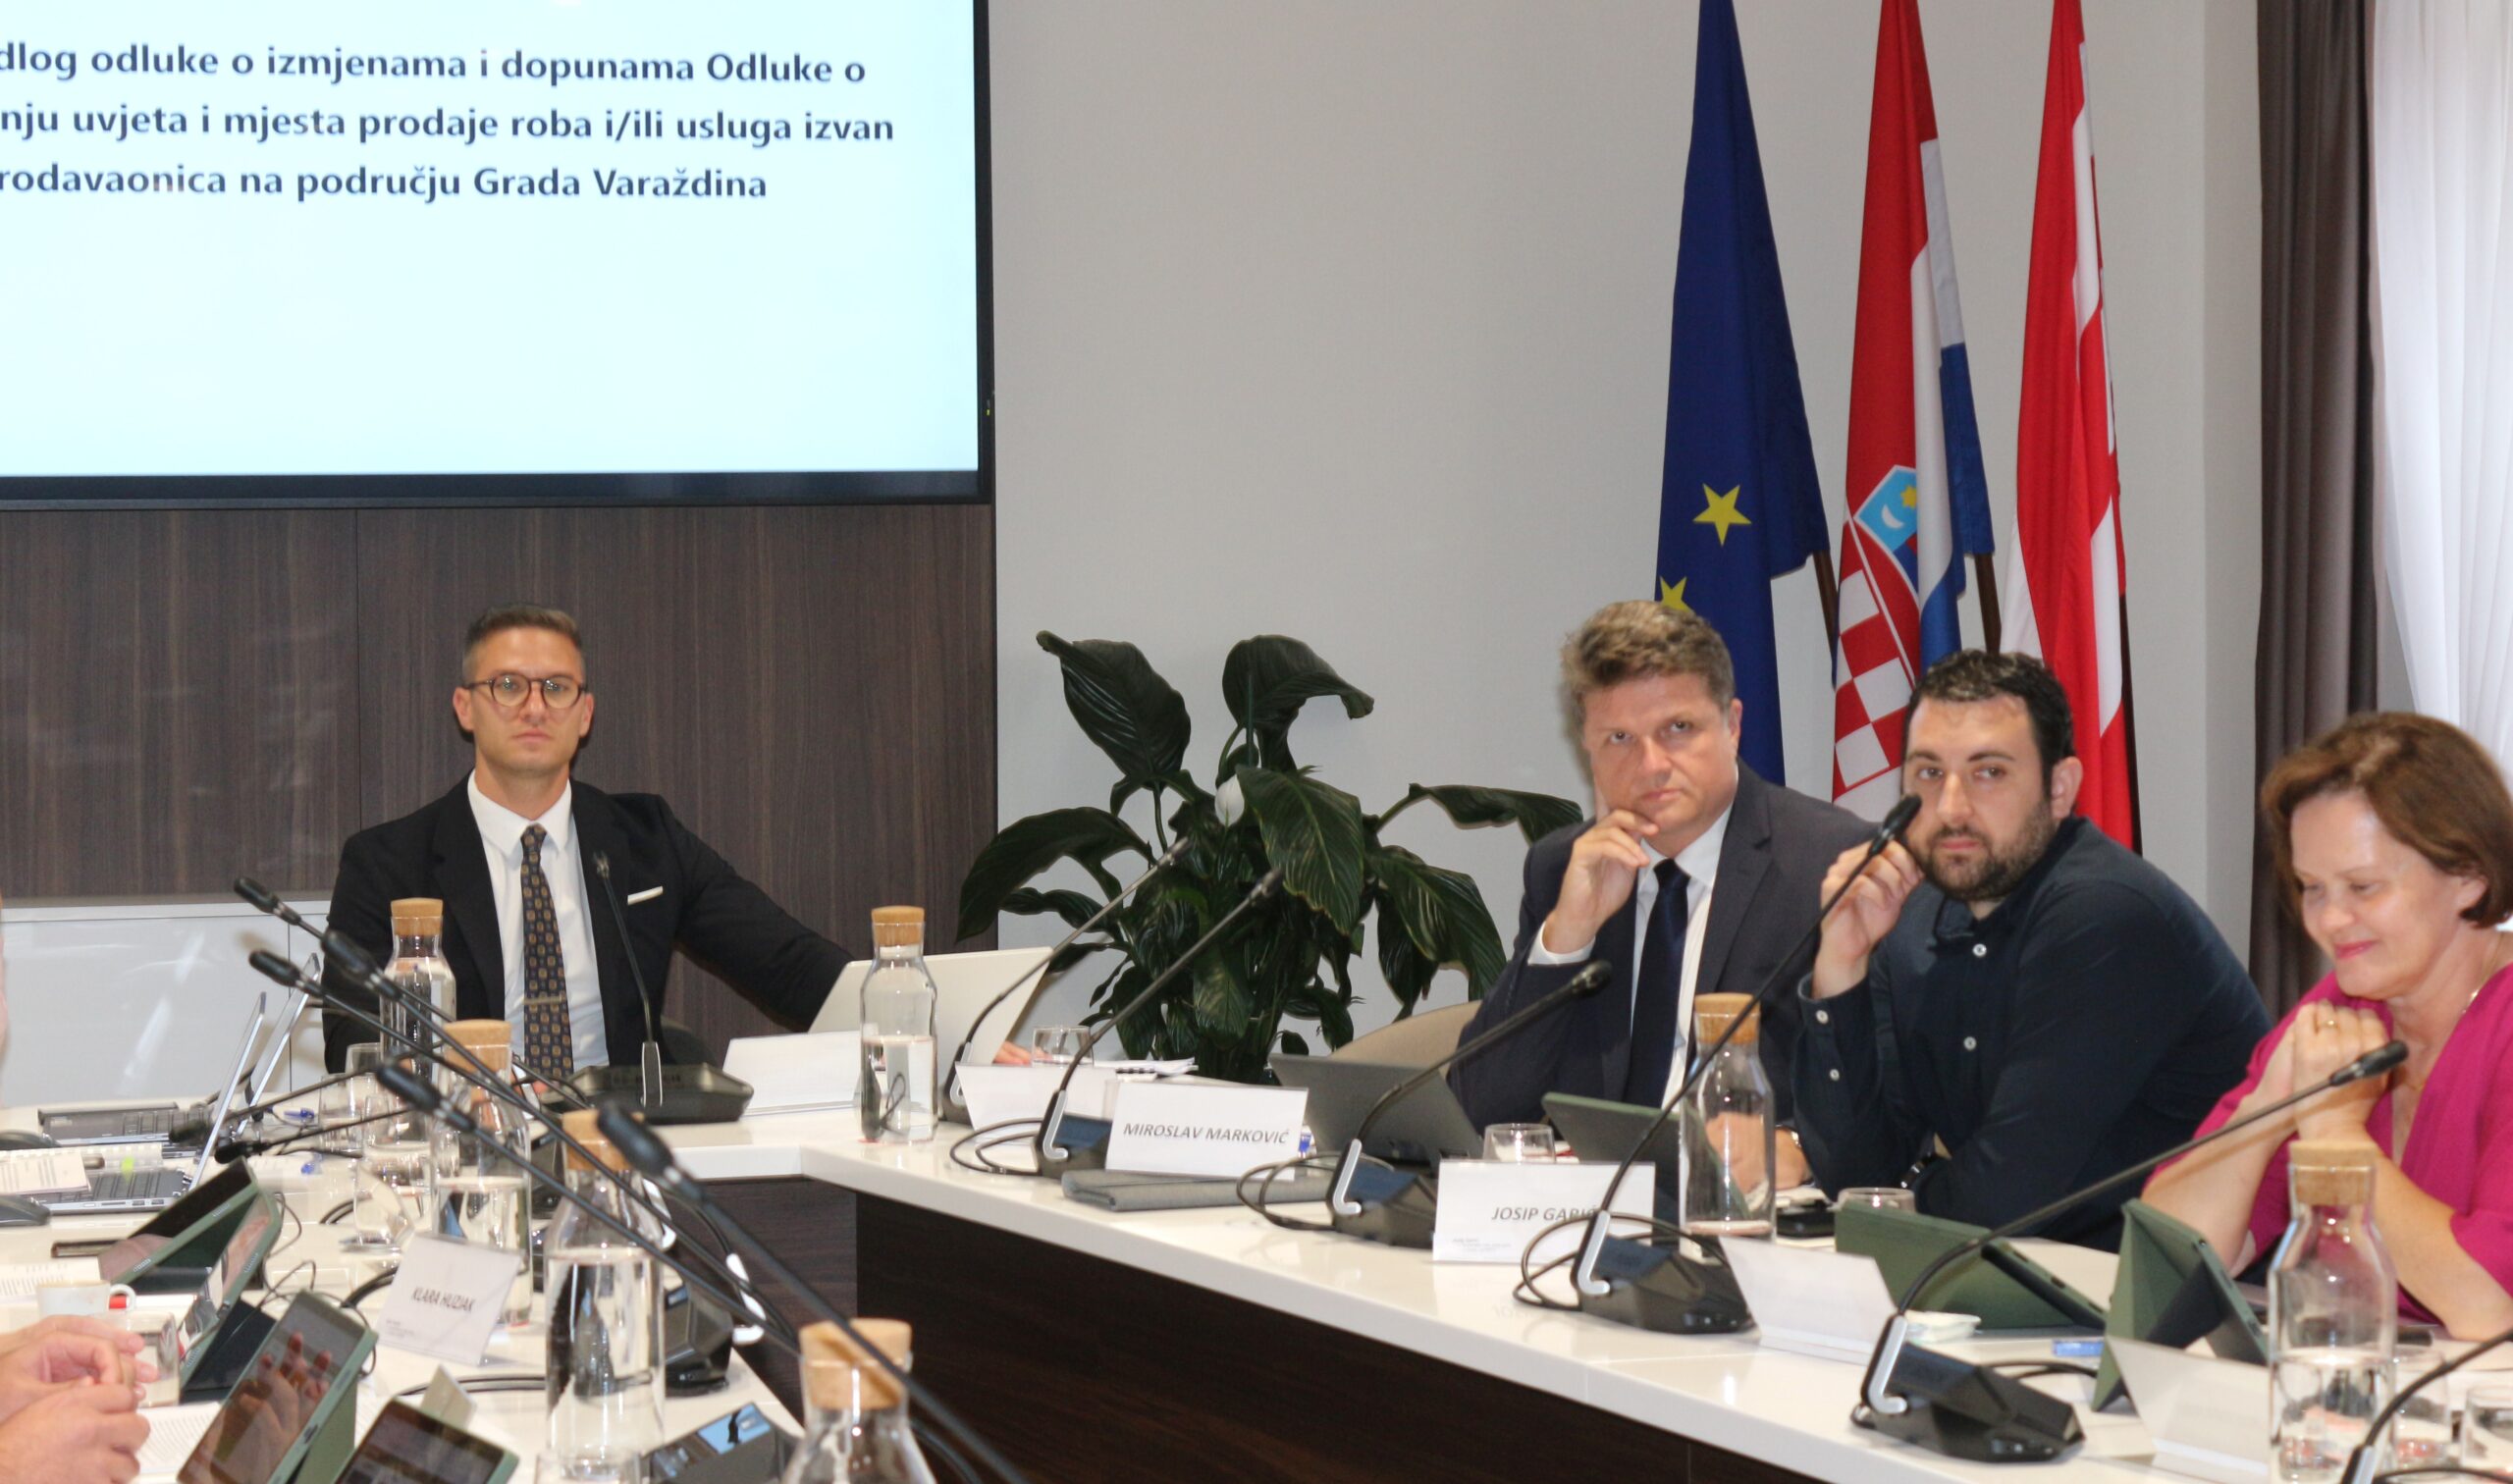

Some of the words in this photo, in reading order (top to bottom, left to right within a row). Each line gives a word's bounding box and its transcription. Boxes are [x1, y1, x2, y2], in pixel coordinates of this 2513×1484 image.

[0, 41, 78, 81] dlog
[90, 43, 220, 75] odluke
[231, 53, 255, 76] o
[267, 47, 467, 85] izmjenama
[479, 50, 489, 78] i
[501, 49, 695, 88] dopunama
[706, 52, 833, 83] Odluke
[843, 62, 867, 83] o
[0, 103, 59, 141] nju
[73, 104, 188, 142] uvjeta
[200, 105, 210, 133] i
[224, 107, 346, 145] mjesta
[358, 107, 500, 146] prodaje
[510, 108, 593, 138] roba
[605, 109, 664, 142] i/ili
[675, 110, 792, 149] usluga
[804, 112, 894, 141] izvan
[0, 162, 227, 193] rodavaonica
[240, 173, 284, 194] na
[296, 165, 461, 205] području
[472, 167, 581, 197] Grada
[592, 167, 768, 198] Varaždina
[1122, 1122, 1203, 1140] MIROSLAV
[1205, 1127, 1289, 1144] MARKOVIĆ
[1492, 1206, 1538, 1221] JOSIP
